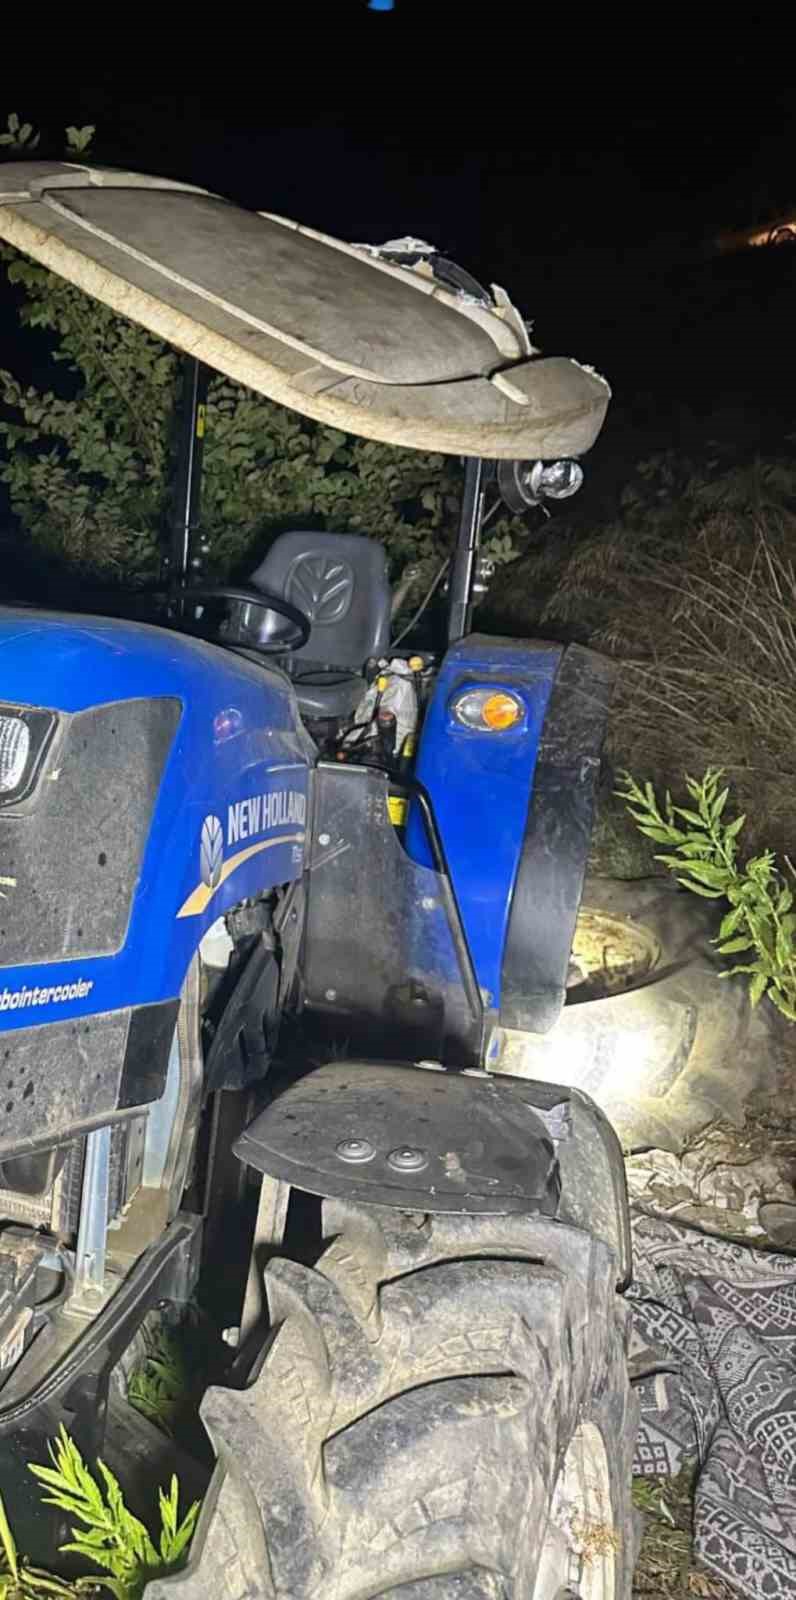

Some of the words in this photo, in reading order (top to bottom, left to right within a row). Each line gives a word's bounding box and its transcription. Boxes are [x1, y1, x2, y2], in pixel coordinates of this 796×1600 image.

[227, 796, 261, 846] NEW
[262, 791, 306, 831] HOLLAND
[0, 977, 94, 1011] bointercooler
